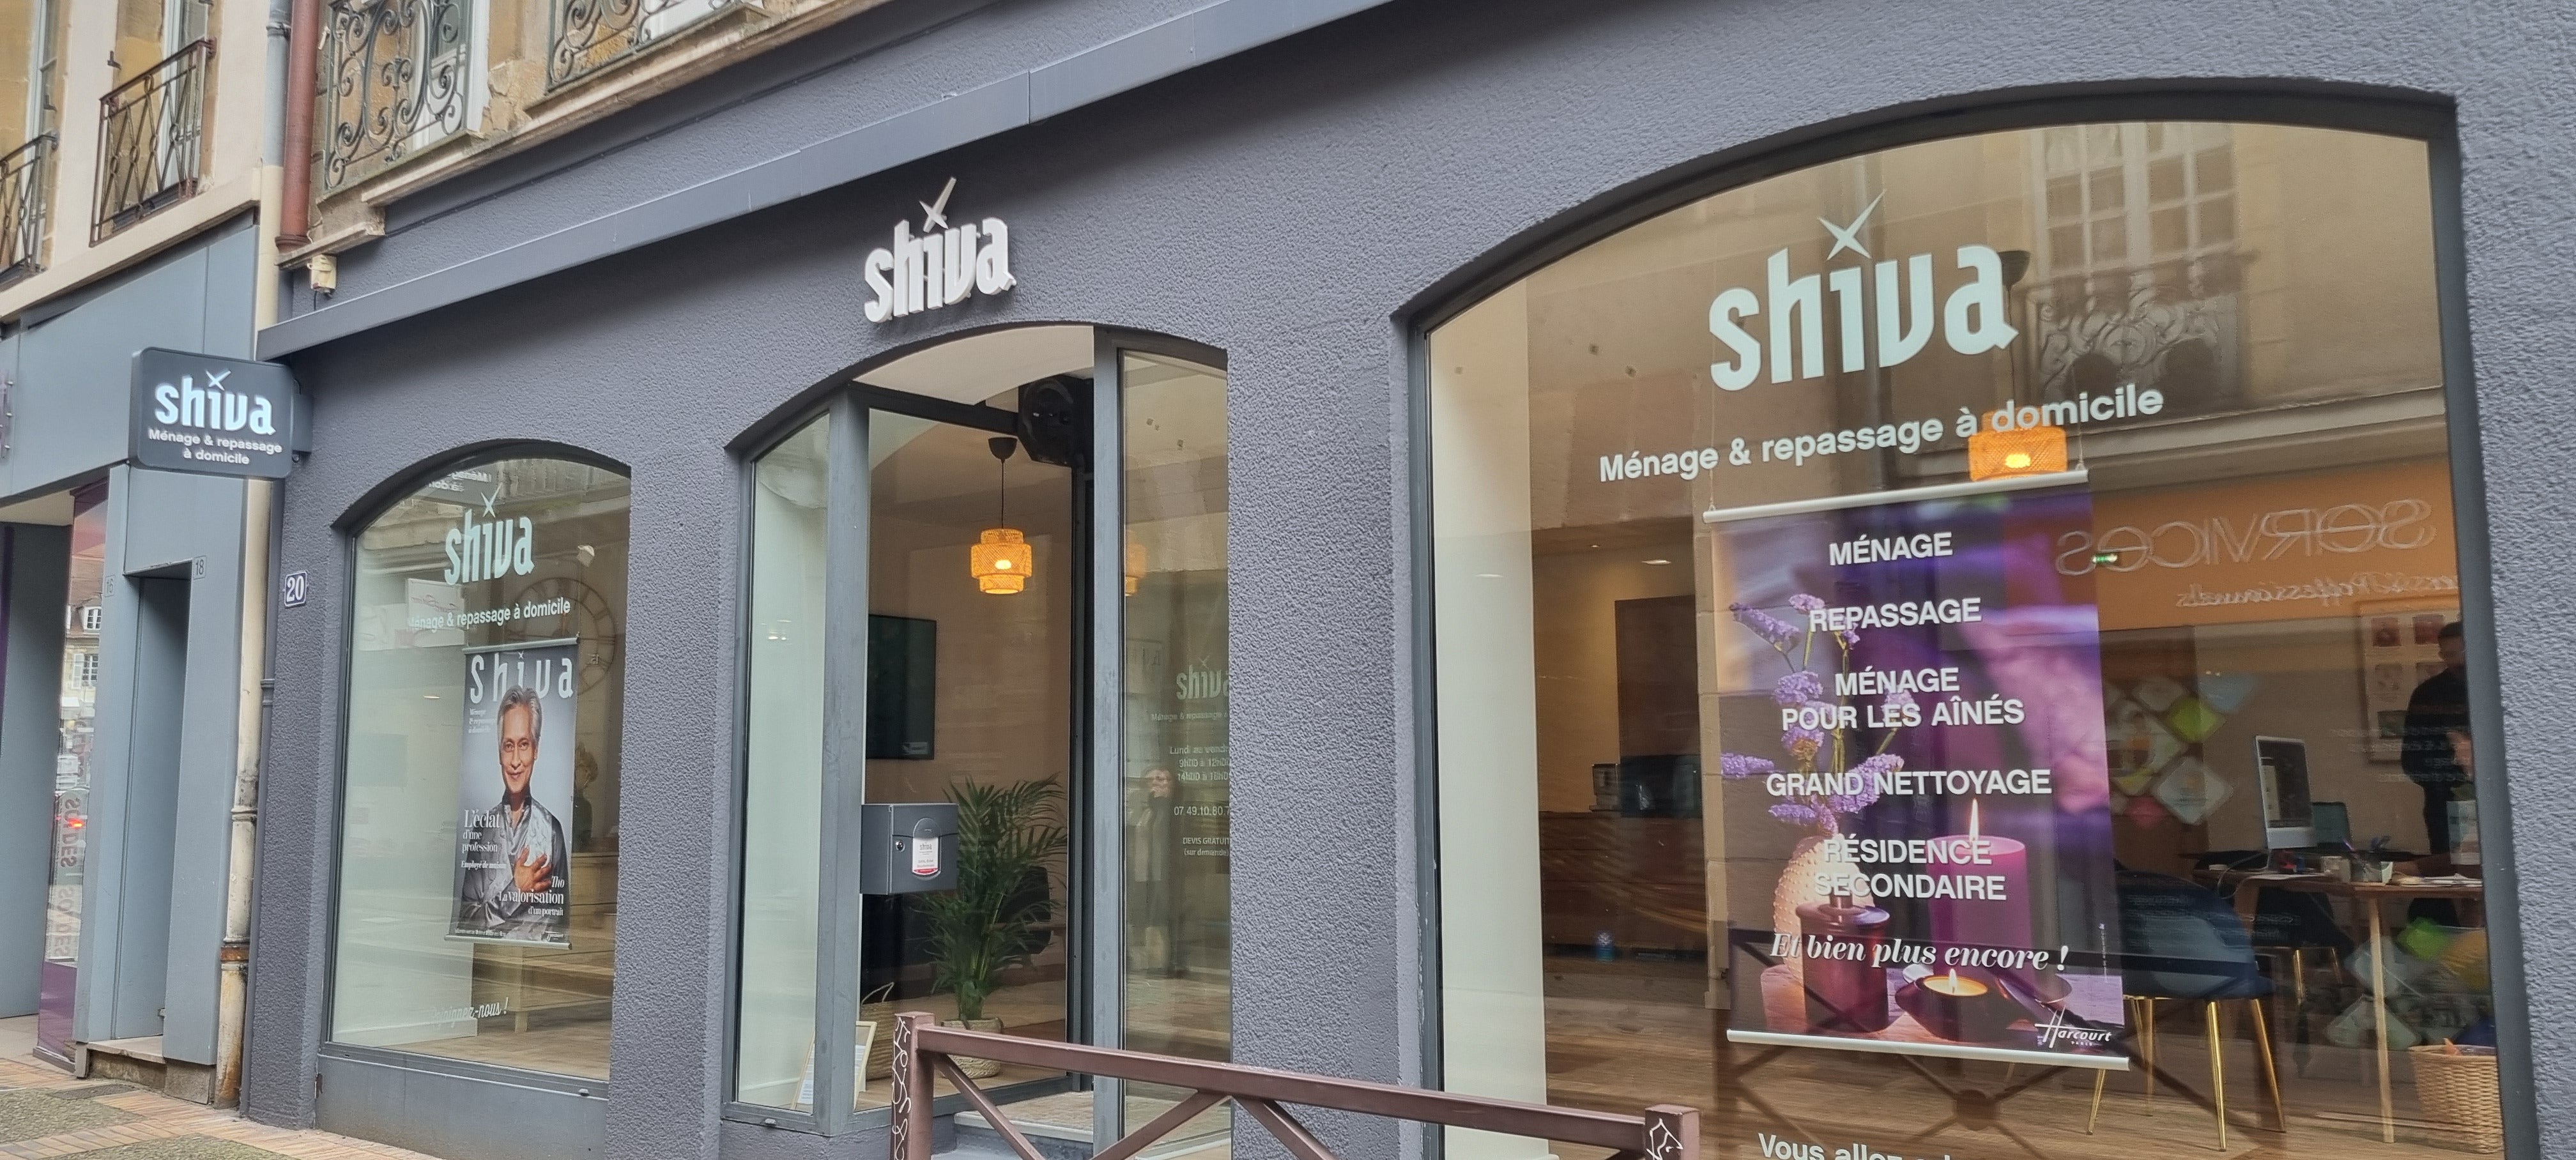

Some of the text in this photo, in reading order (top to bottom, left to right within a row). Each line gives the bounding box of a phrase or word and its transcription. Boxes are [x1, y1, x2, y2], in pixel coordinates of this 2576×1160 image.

[864, 176, 1016, 323] shiva
[1708, 192, 2019, 392] shiva
[155, 368, 276, 436] shiva
[148, 429, 282, 455] Ménage & repassage
[1599, 383, 2164, 482] Ménage & repassage à domicile
[183, 448, 250, 464] à domicile
[445, 484, 535, 585] shiva
[1829, 532, 1953, 566] MÉNAGE
[195, 560, 204, 575] 18
[105, 579, 114, 593] 16
[287, 575, 304, 600] 20
[447, 612, 454, 627] &
[457, 608, 511, 629] repassage
[513, 603, 521, 619] à
[523, 597, 571, 618] domicile
[1809, 598, 1982, 632] REPASSAGE
[470, 651, 574, 703] Shiva
[1835, 666, 1959, 696] MÉNAGE
[1782, 694, 2025, 731] POUR LES AÎNÉS
[1767, 769, 2052, 797] GRAND NETTOYAGE
[464, 809, 500, 828] L'éclat
[462, 841, 498, 853] profession
[463, 829, 482, 840] d'une
[1823, 834, 1993, 865] RÉSIDENCE
[1814, 873, 2007, 901] SECONDAIRE
[1770, 932, 1801, 958] Et
[1807, 934, 1866, 962] bien
[1873, 938, 1936, 968] plus
[1945, 948, 2049, 970] encore
[2056, 946, 2069, 971] !
[2034, 1004, 2113, 1048] Harcourt
[1758, 1133, 1903, 1160] Vous all
